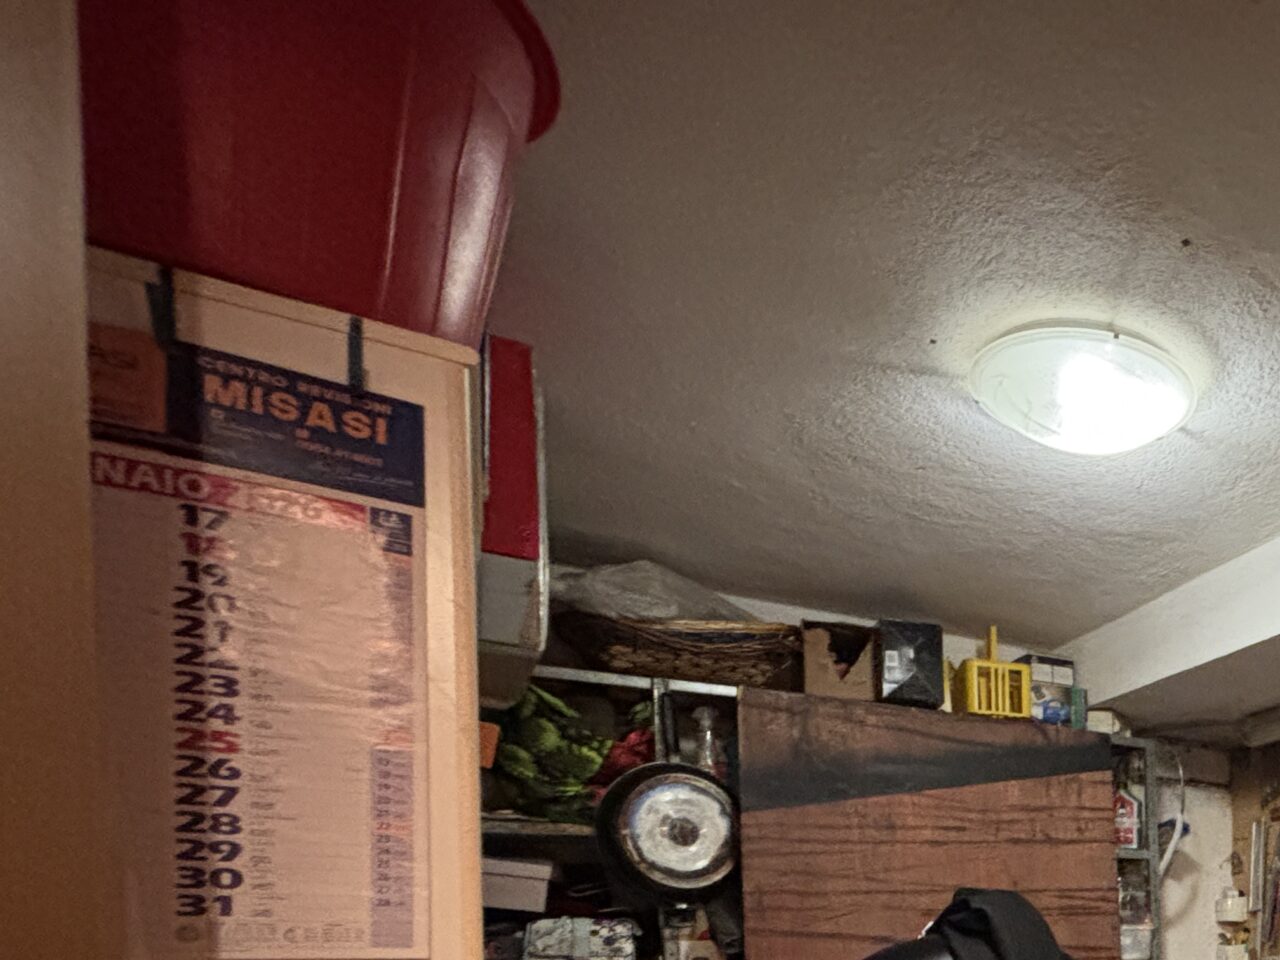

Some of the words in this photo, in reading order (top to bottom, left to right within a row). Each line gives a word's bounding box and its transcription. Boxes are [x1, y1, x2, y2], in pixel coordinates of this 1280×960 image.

[203, 374, 390, 446] MISASI
[178, 503, 230, 531] 17
[171, 614, 234, 643] 21
[173, 670, 241, 698] 23
[173, 699, 242, 726] 24
[174, 727, 243, 754] 25
[174, 754, 243, 781] 26
[174, 782, 241, 808] 27
[174, 810, 243, 835] 28
[174, 838, 243, 862] 29
[174, 865, 244, 890] 30
[174, 894, 233, 917] 31
